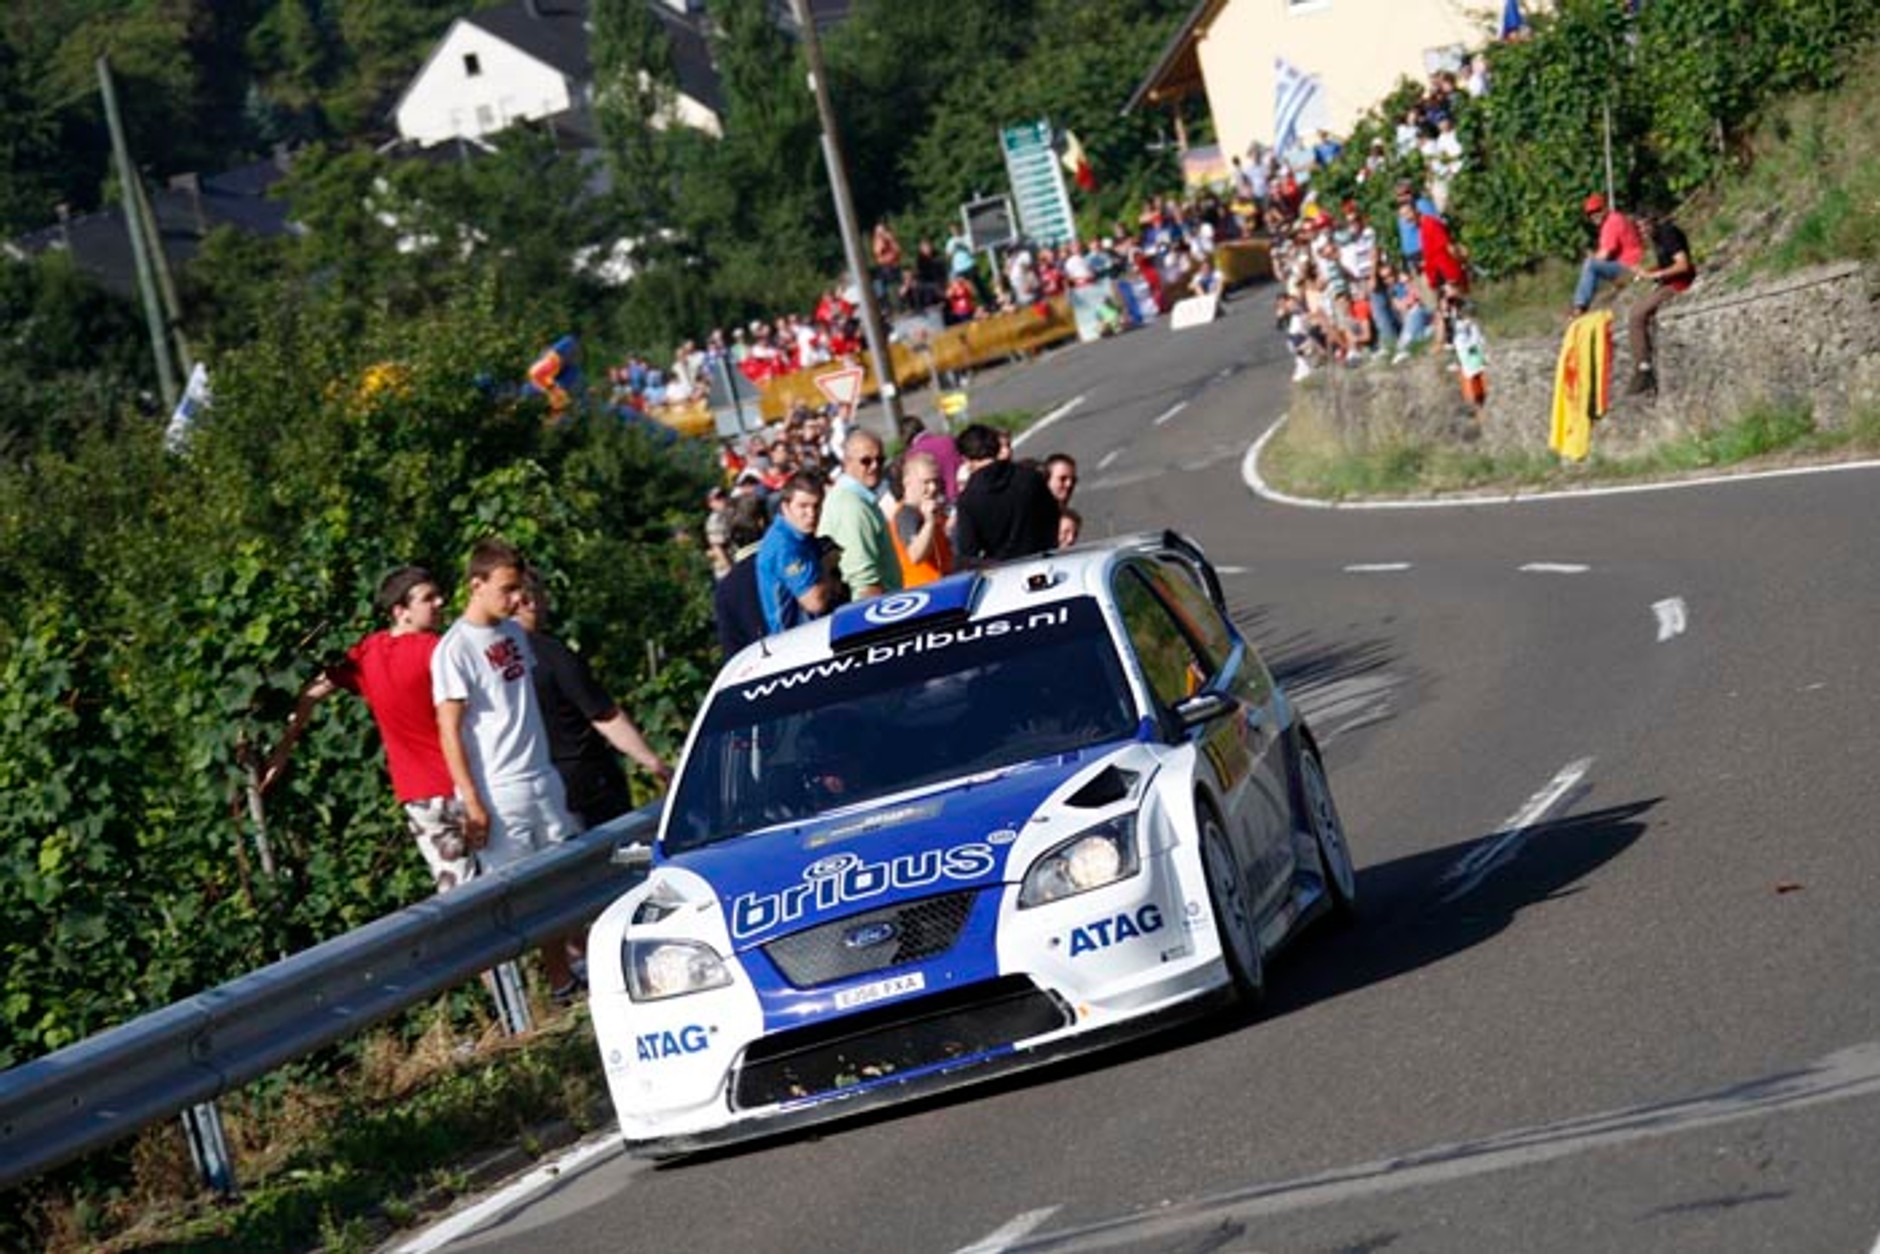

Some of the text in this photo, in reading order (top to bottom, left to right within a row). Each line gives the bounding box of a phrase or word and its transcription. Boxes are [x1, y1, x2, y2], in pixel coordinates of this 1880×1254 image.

[743, 607, 1068, 700] www.bribus.nl
[733, 843, 995, 939] bribus
[1069, 904, 1164, 957] ATAG
[636, 1024, 709, 1062] ATAG
